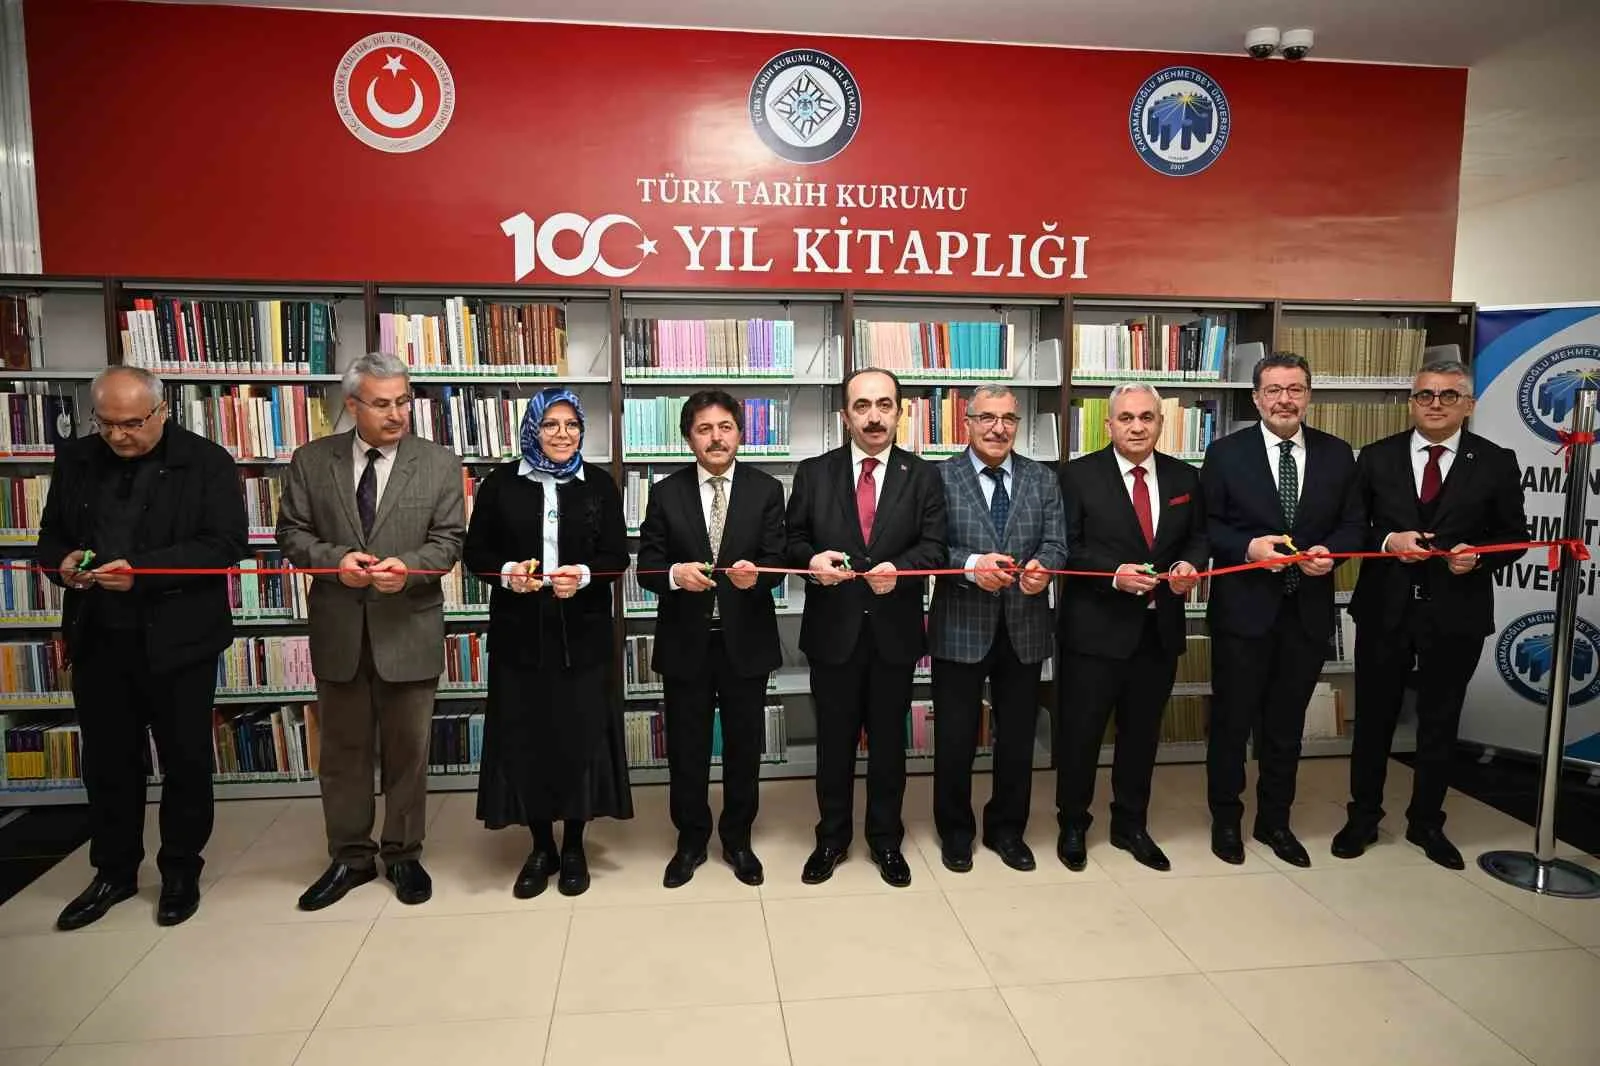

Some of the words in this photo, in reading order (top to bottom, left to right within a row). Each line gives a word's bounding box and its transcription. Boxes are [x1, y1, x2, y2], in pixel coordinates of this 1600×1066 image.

[773, 54, 813, 71] KURUMU
[832, 65, 845, 81] YIL
[1157, 70, 1211, 88] MEHMETBEY
[636, 172, 724, 204] TÜRK
[731, 176, 827, 207] TARİH
[836, 183, 968, 211] KURUMU
[673, 225, 774, 273] YIL
[792, 216, 1090, 280] KİTAPLIĞI
[1550, 348, 1600, 361] MEHMET
